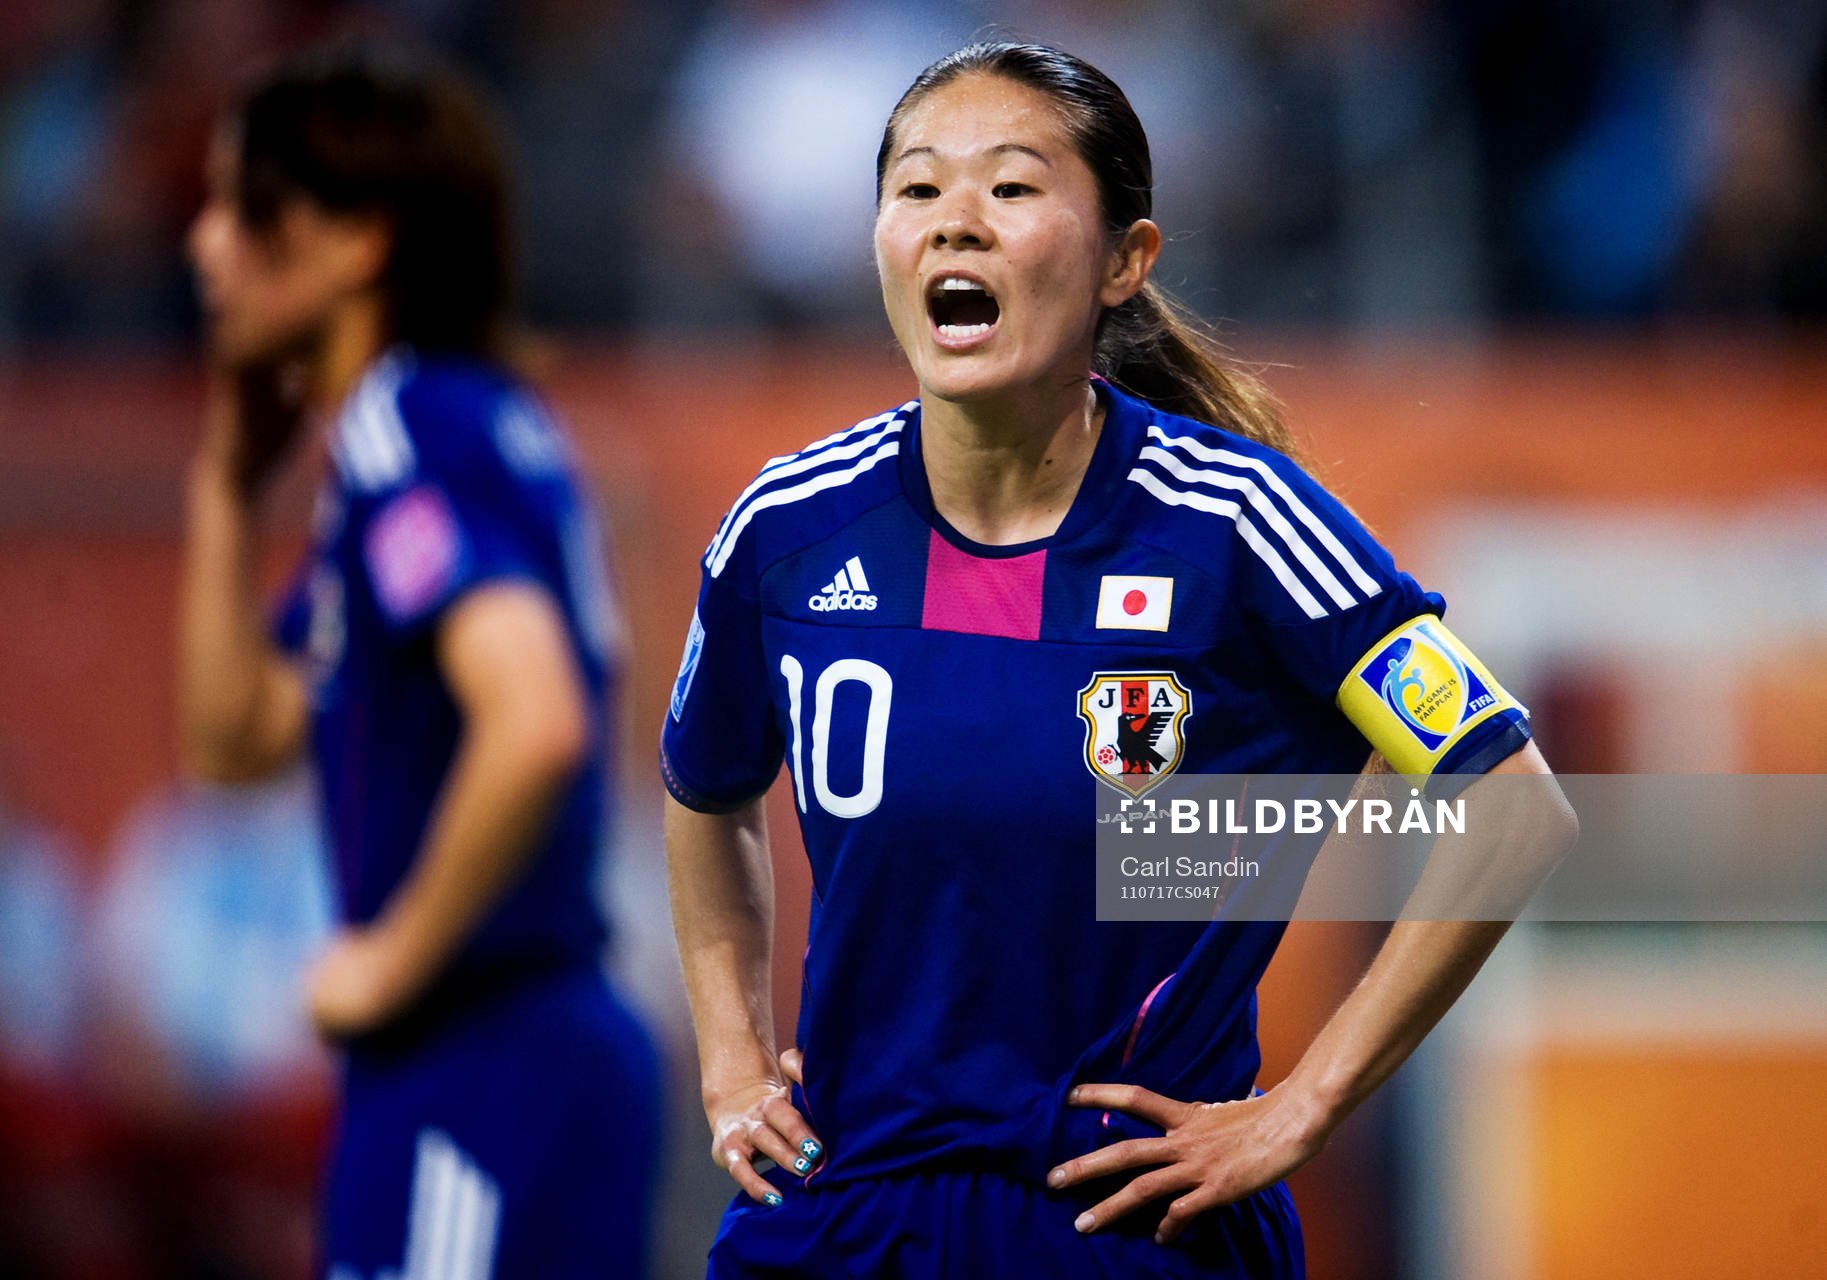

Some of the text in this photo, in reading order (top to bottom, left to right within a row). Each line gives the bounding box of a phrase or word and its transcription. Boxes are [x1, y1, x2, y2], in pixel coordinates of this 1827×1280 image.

[808, 589, 878, 612] adidas
[1414, 678, 1457, 715] MY GAME IS
[1419, 690, 1453, 722] FAIR PLAY
[1468, 694, 1494, 712] FIFA
[780, 654, 893, 819] 10
[1096, 808, 1173, 824] JAPAN
